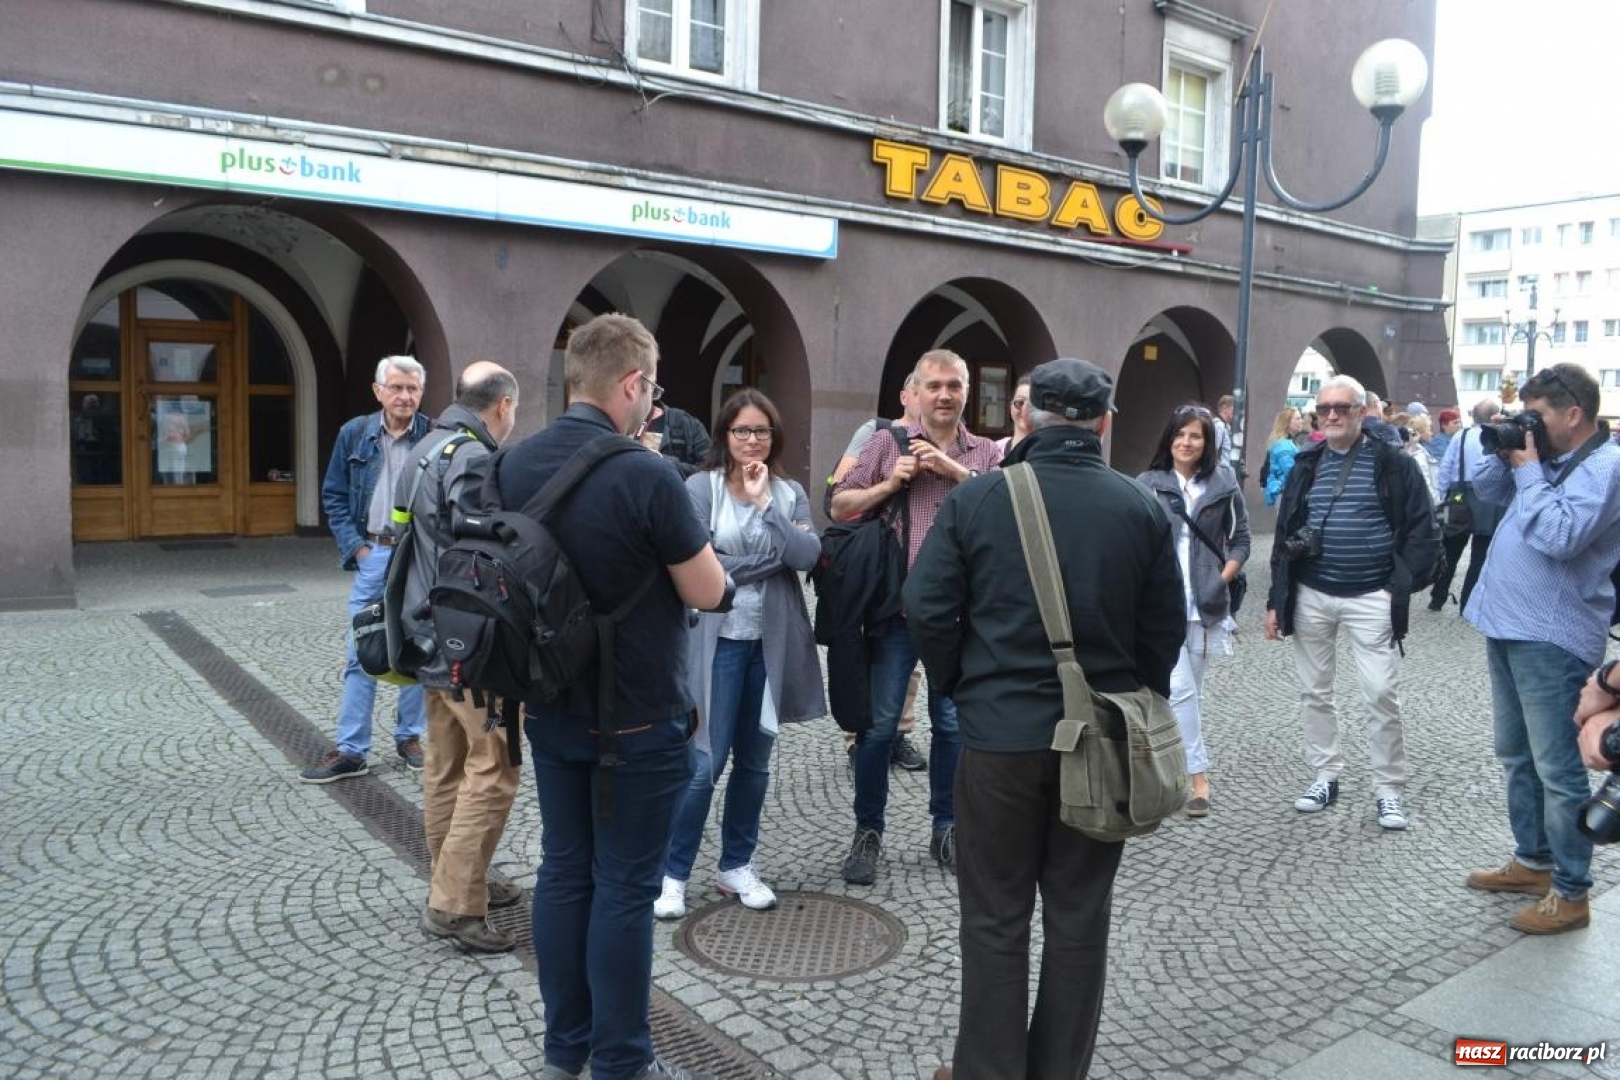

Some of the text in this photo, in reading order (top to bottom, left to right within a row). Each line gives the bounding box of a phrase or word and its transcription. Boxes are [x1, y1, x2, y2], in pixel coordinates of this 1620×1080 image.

[221, 148, 362, 183] plus bank
[872, 139, 1165, 242] TABAC
[631, 200, 731, 230] plus bank
